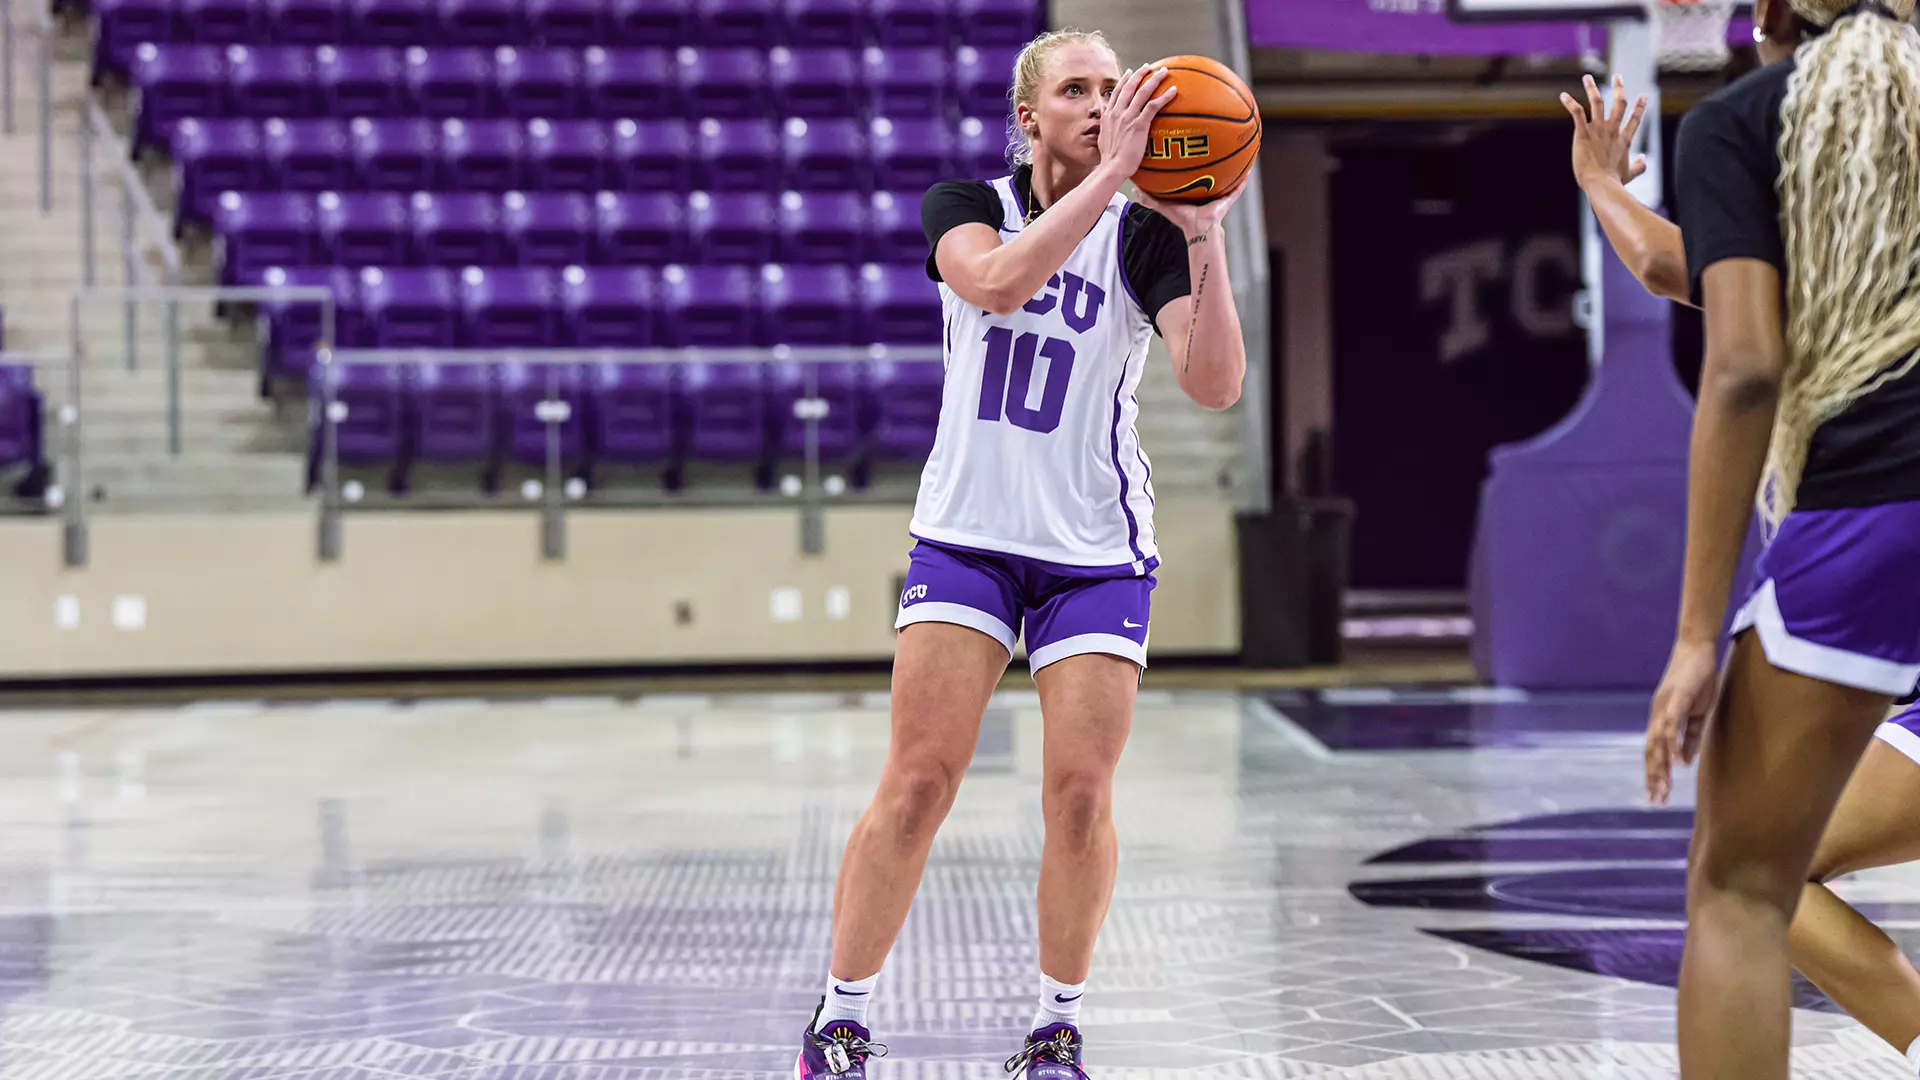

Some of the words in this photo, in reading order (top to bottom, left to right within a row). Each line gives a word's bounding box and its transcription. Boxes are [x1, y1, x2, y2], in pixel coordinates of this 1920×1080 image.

[1145, 135, 1209, 159] ELIT
[982, 271, 1106, 335] CU
[977, 325, 1076, 435] 10
[903, 584, 928, 606] TCU
